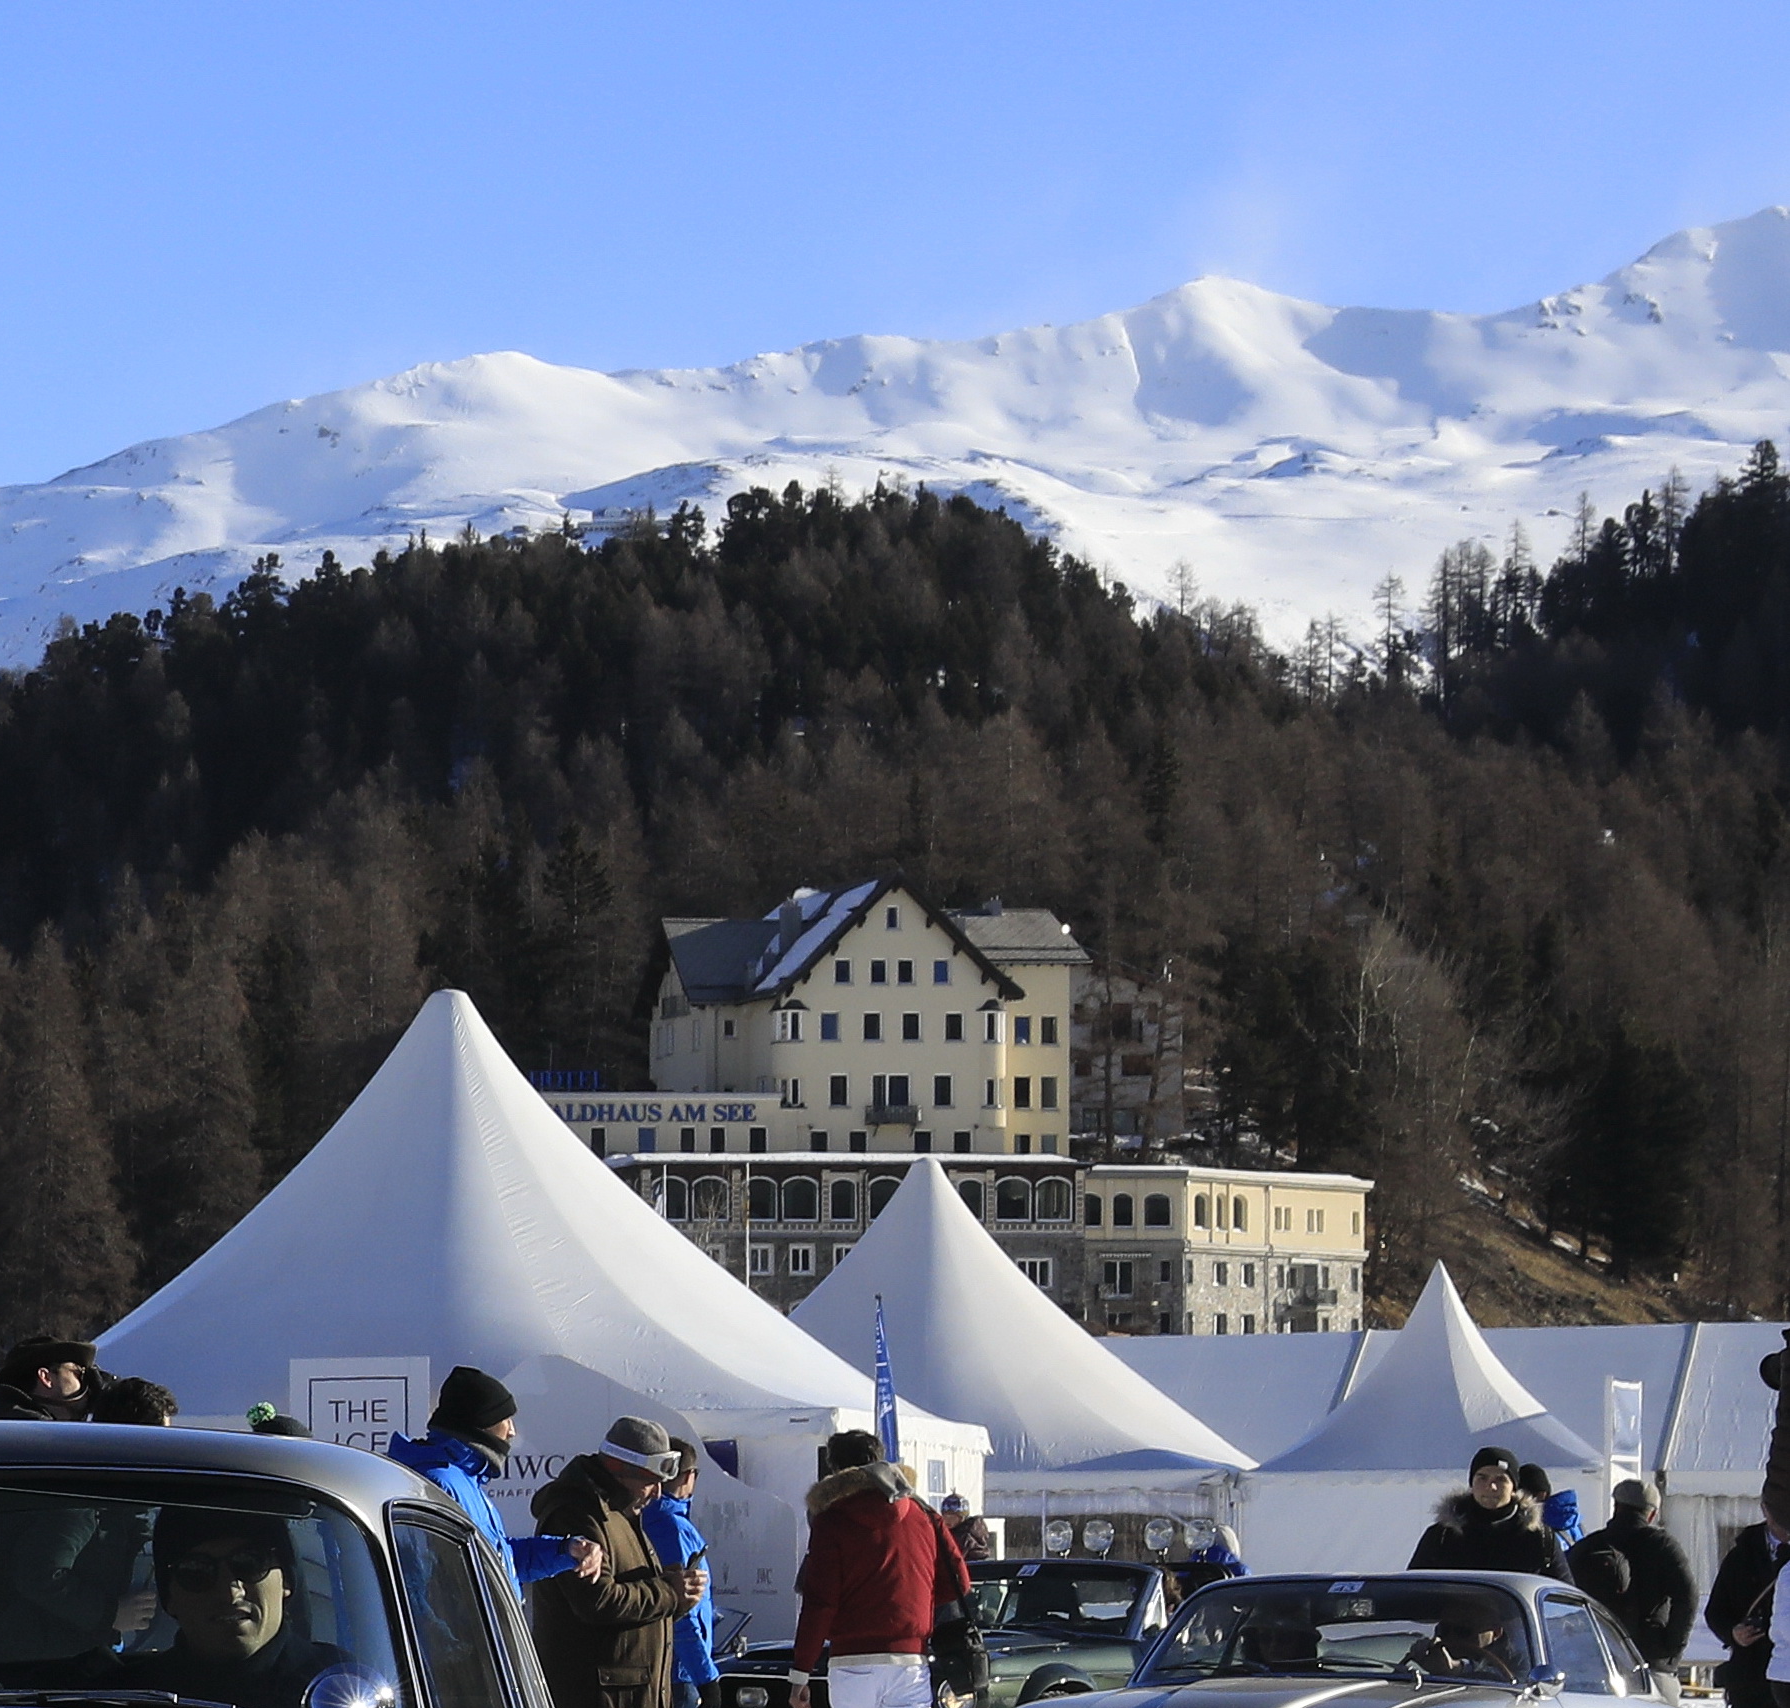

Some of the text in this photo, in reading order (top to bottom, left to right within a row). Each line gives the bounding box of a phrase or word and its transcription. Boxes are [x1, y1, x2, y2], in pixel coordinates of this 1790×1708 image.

[530, 1070, 600, 1090] HOTEL
[551, 1103, 757, 1122] ALDHAUS AM SEE
[328, 1399, 388, 1423] THE
[502, 1454, 565, 1480] IWC
